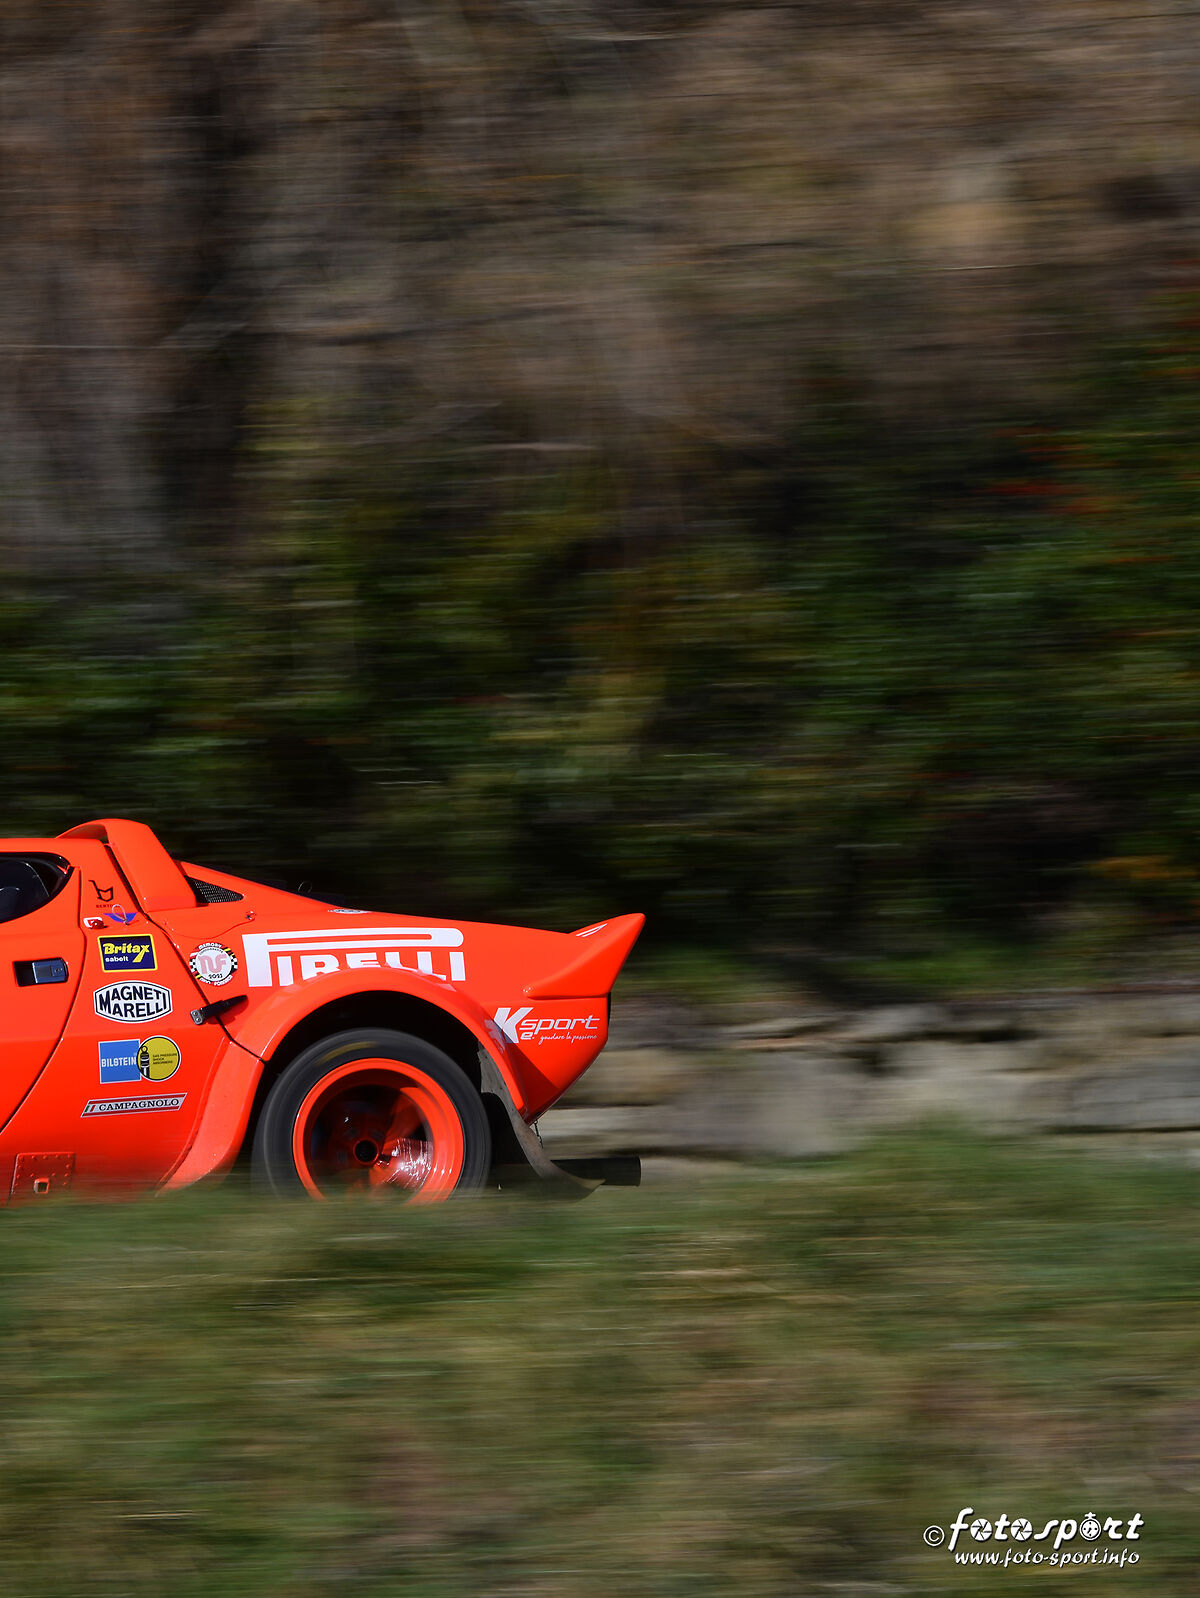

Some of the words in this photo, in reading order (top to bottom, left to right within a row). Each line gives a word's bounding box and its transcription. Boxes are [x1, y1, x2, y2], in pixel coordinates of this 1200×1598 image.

[103, 943, 150, 962] Britax
[99, 985, 167, 1009] MAGNETI
[99, 996, 167, 1018] MARELLI
[101, 1056, 137, 1067] BILSTEIN
[98, 1098, 179, 1111] CAMPAGNOLO
